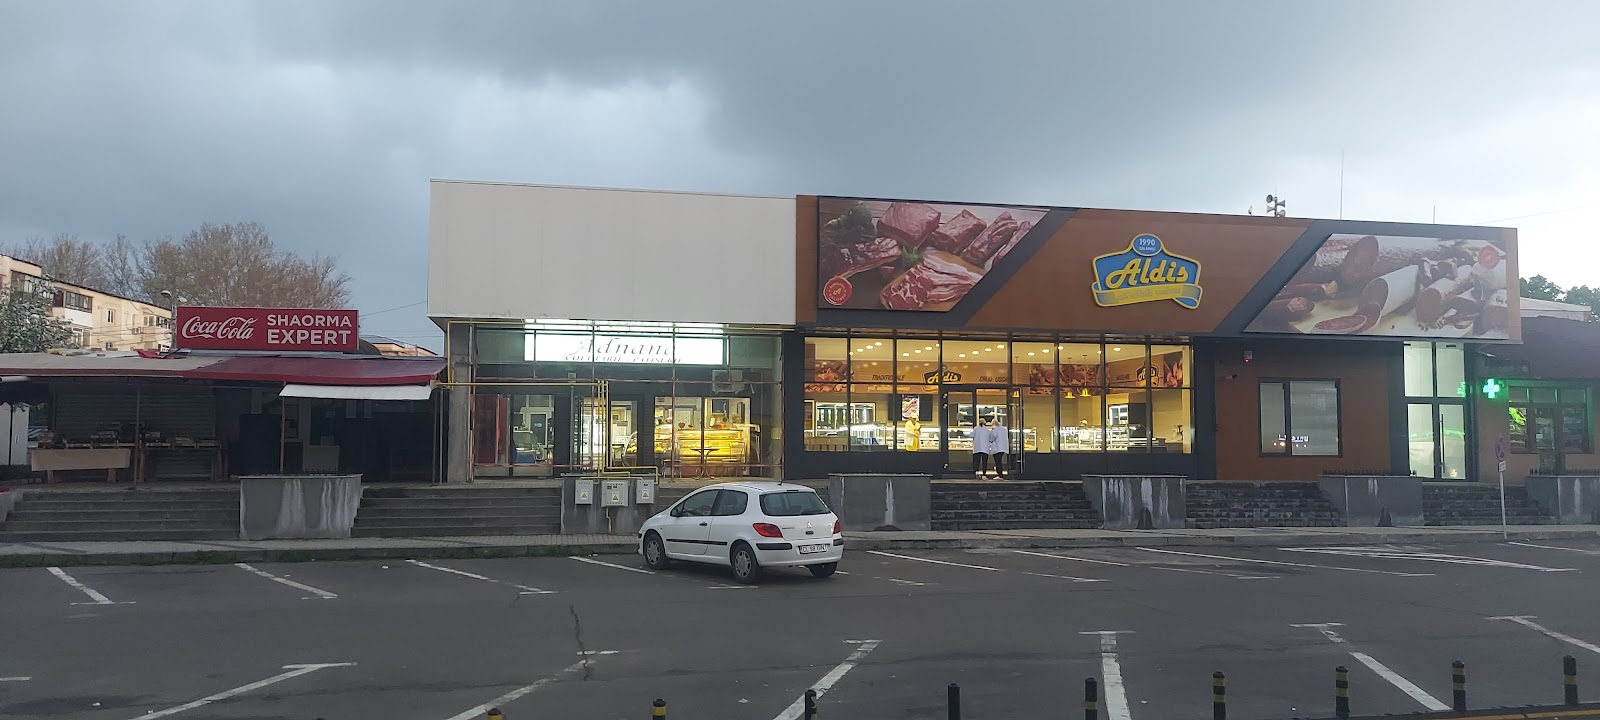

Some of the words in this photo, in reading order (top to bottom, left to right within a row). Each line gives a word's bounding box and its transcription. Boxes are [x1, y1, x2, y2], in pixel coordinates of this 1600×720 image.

[1139, 238, 1156, 246] 1990
[1105, 258, 1189, 290] Aldis
[181, 315, 258, 340] Coca-Cola
[267, 314, 352, 328] SHAORMA
[267, 329, 352, 345] EXPERT
[927, 372, 958, 383] Adis
